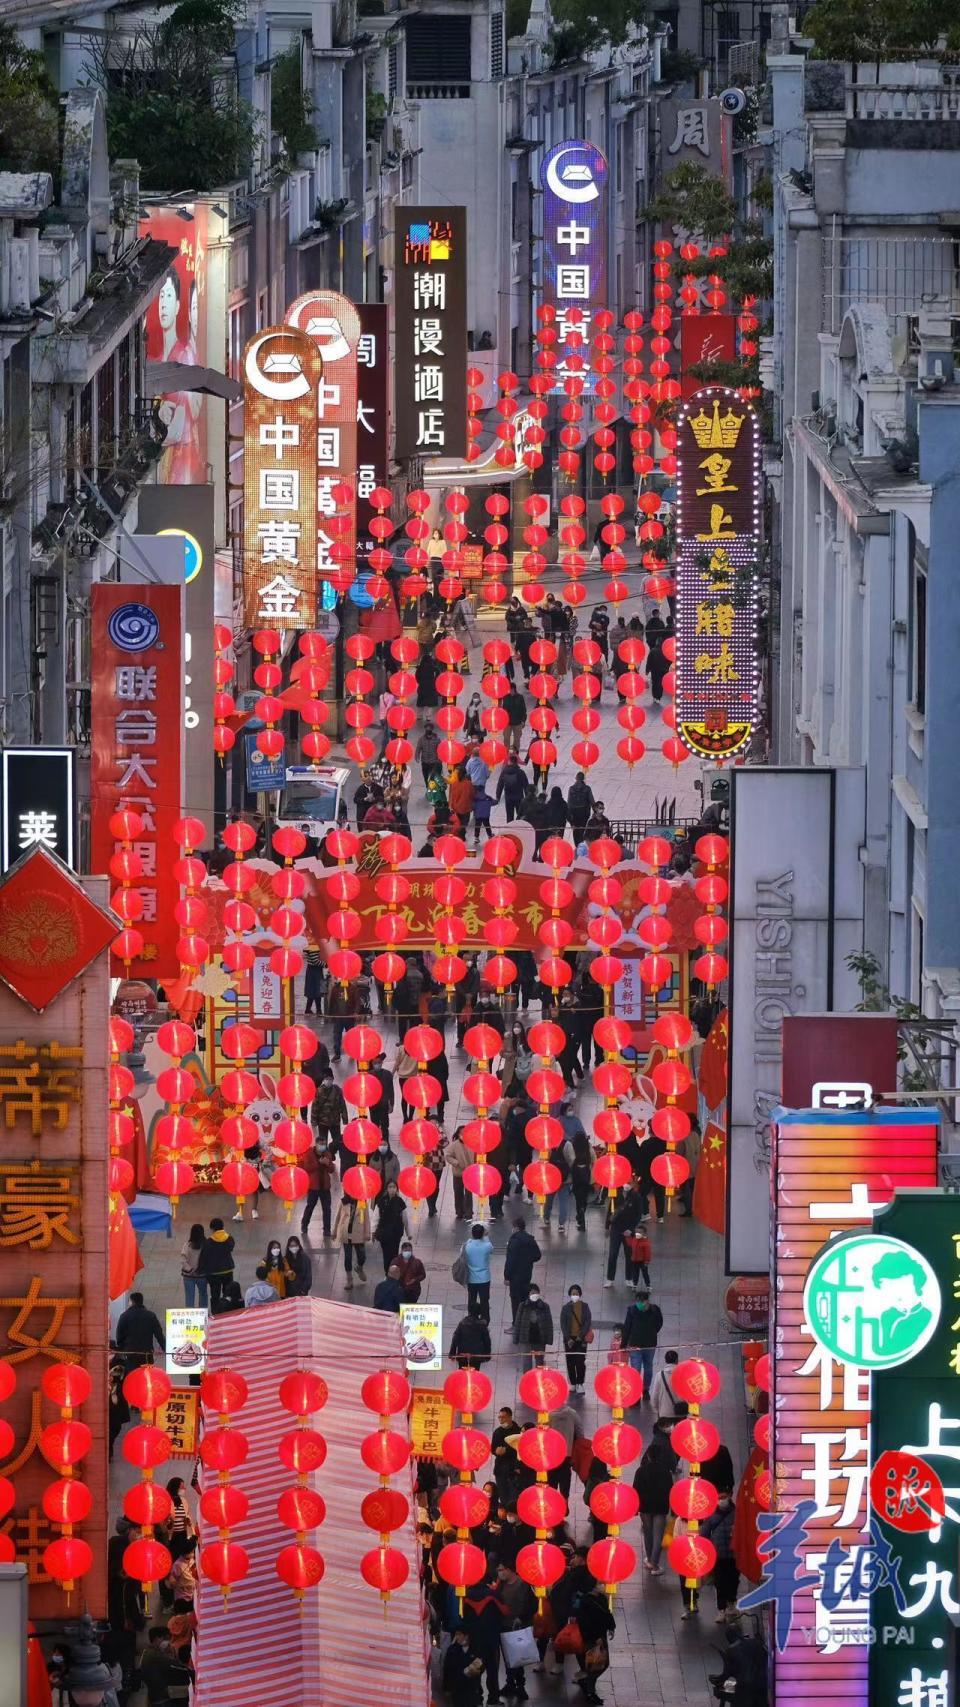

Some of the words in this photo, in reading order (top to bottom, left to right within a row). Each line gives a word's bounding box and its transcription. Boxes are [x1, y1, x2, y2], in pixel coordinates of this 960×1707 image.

[413, 271, 446, 446] 潮漫酒店
[257, 415, 302, 618] 中国黄金
[18, 810, 58, 849] 莱
[165, 1402, 186, 1449] 原切牛肉
[423, 1407, 441, 1452] 牛肉干巴
